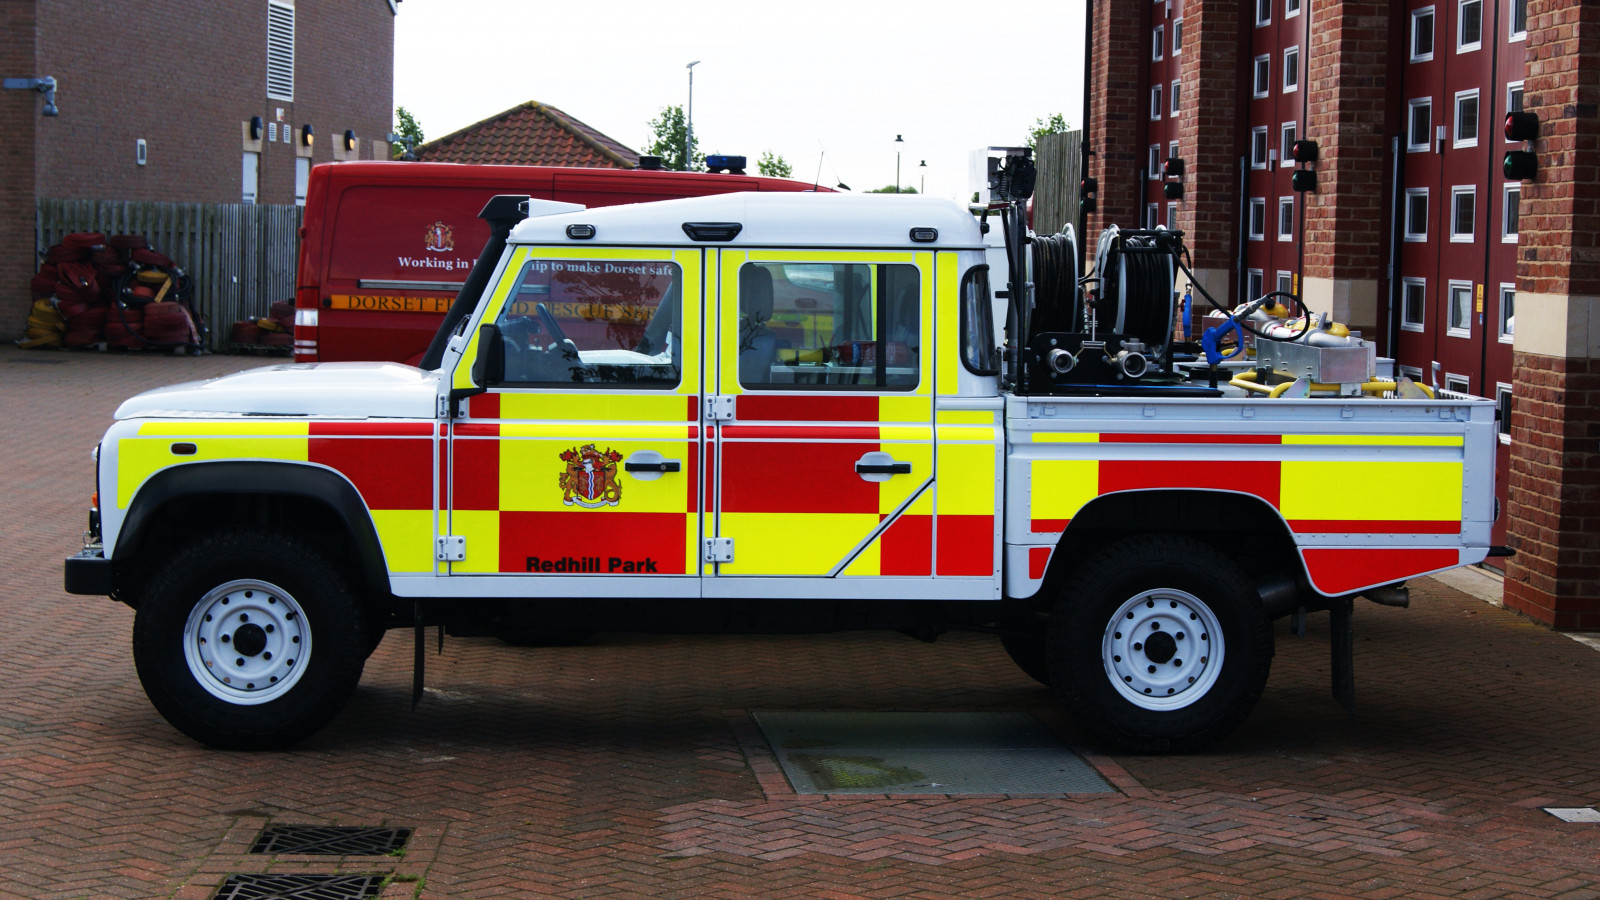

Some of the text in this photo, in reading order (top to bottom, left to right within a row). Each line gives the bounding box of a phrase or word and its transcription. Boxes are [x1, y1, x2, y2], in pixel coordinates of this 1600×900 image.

[398, 257, 453, 270] Working
[456, 258, 469, 268] in
[551, 262, 564, 271] to
[567, 262, 600, 273] make
[605, 263, 646, 275] Dorset
[348, 295, 427, 311] DORSET
[435, 297, 452, 311] FI
[622, 303, 657, 319] SER
[526, 556, 658, 573] Redhill Park
